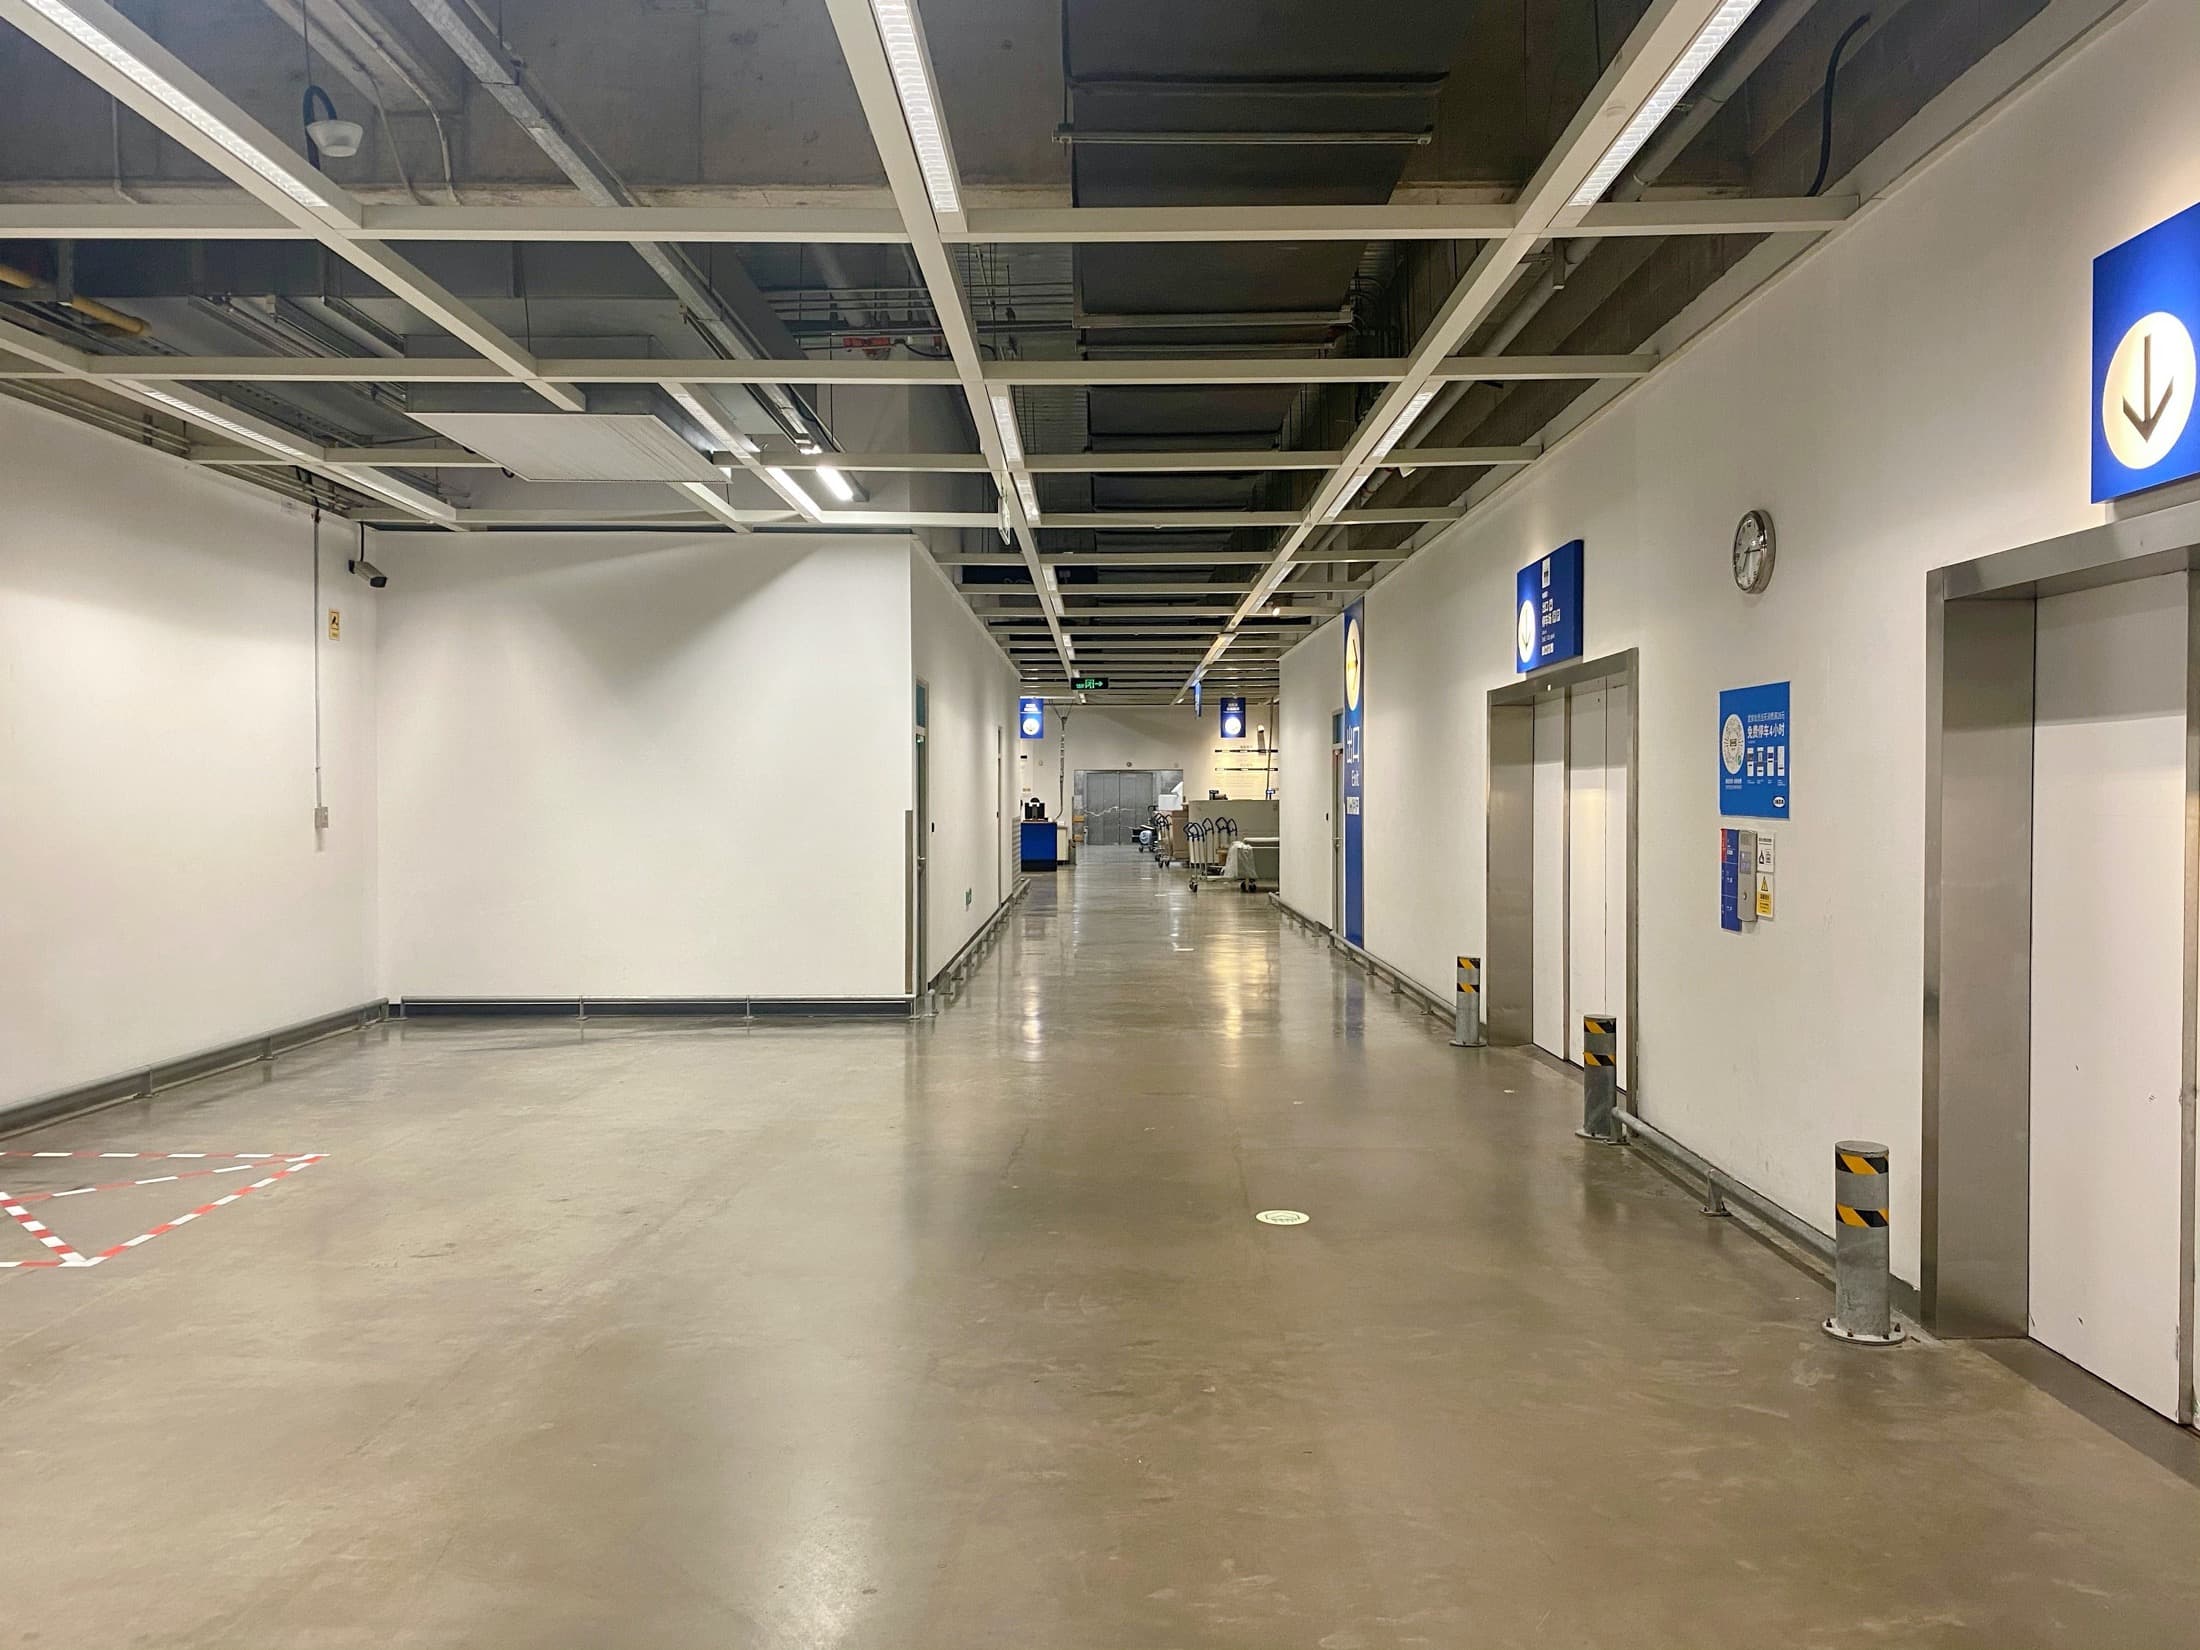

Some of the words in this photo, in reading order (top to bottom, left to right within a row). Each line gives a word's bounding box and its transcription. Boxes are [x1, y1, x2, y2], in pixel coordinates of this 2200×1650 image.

[1346, 725, 1360, 764] 出口
[1747, 722, 1785, 739] 免费停车4小时
